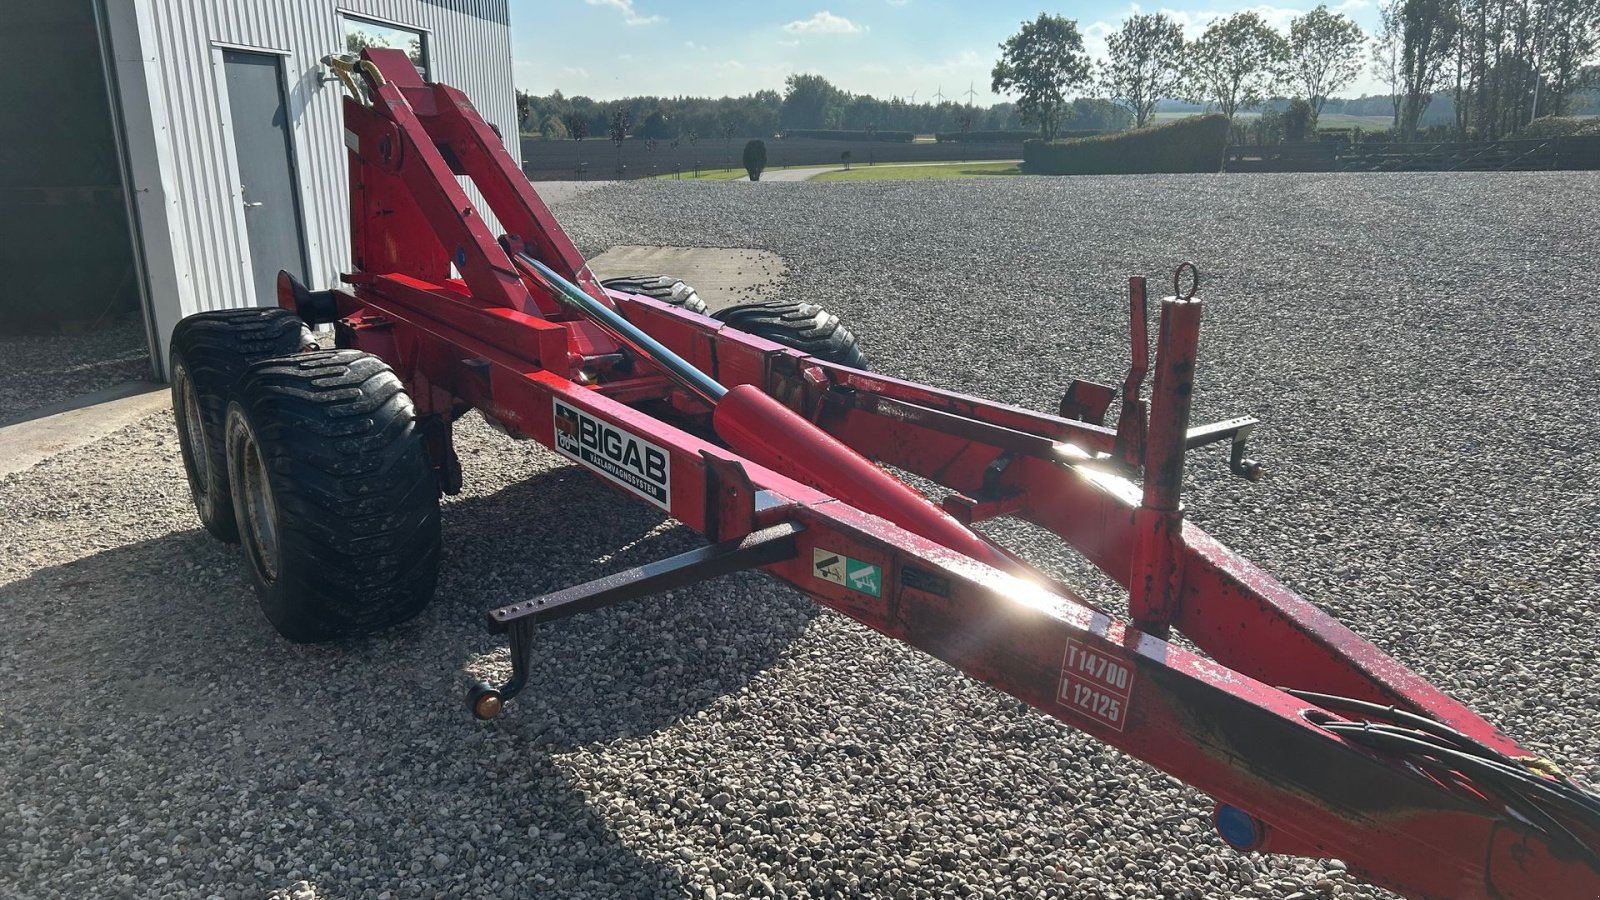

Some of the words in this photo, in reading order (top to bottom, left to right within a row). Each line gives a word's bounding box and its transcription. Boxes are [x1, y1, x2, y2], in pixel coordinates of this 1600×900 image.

[580, 415, 667, 485] BIGAB
[1061, 678, 1069, 700] L
[1074, 683, 1120, 722] 12125
